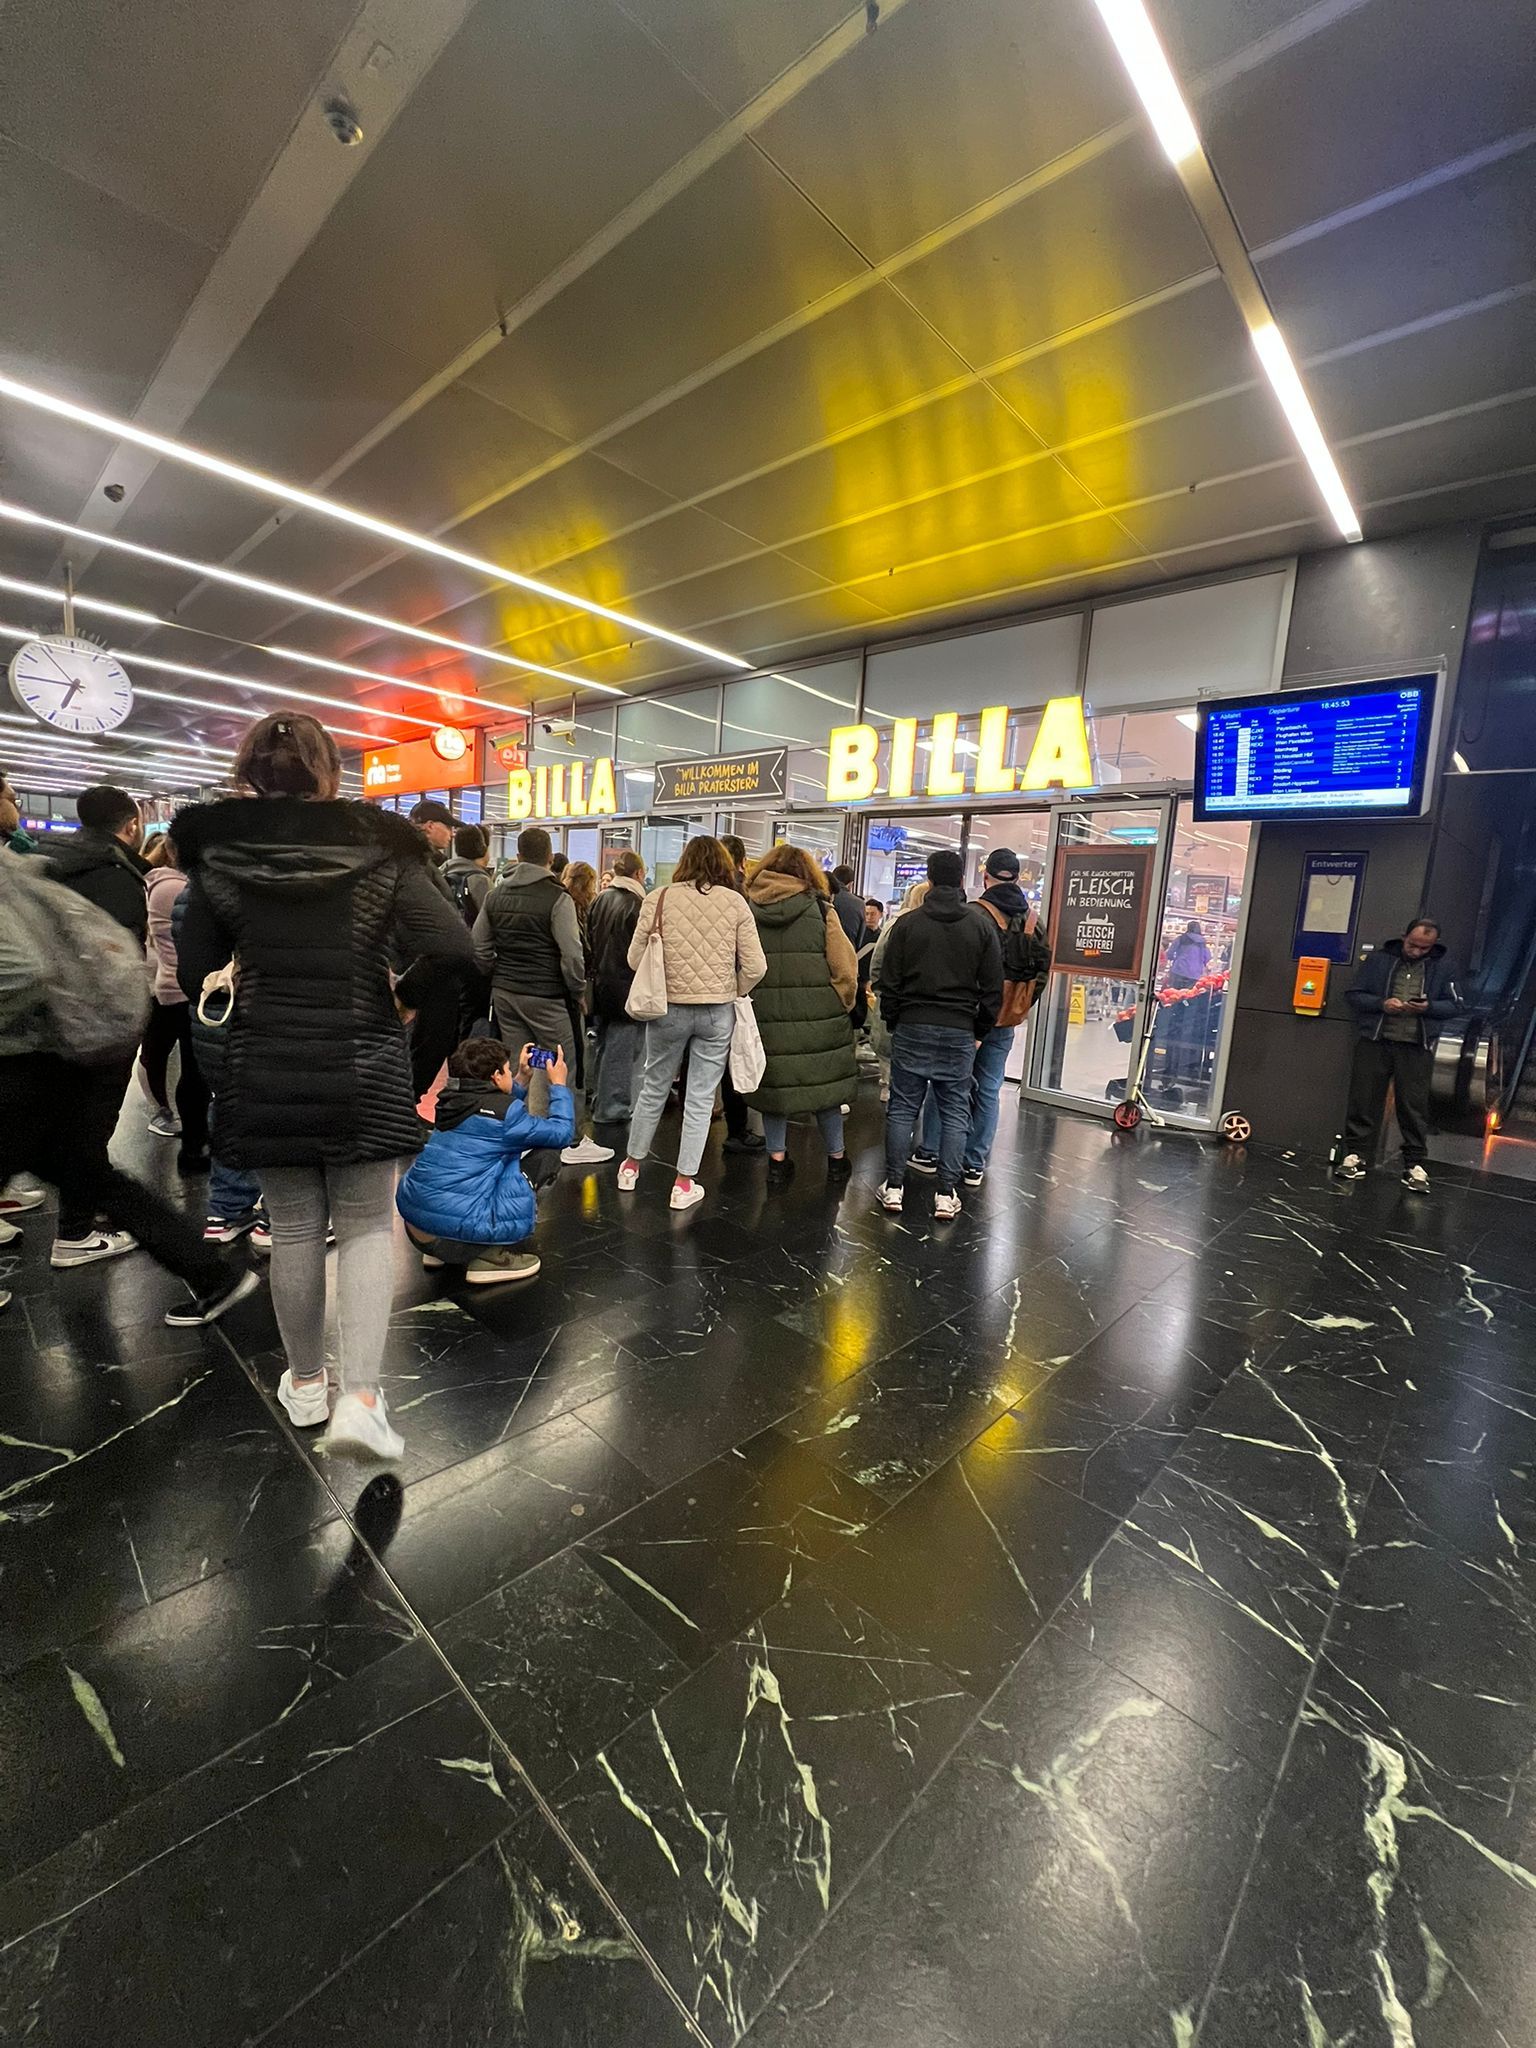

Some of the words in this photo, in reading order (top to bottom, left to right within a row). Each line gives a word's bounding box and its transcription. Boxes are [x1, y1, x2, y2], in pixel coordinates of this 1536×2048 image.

[1268, 706, 1300, 715] Departure
[827, 696, 1093, 801] BILLA
[681, 764, 744, 781] WILLKOMMEN
[747, 761, 759, 775] IM
[508, 757, 617, 819] BILLA
[675, 782, 696, 796] BILLA
[699, 777, 759, 795] PRATERSTERN
[1311, 860, 1358, 869] Entwerter
[1068, 878, 1134, 896] FLEISCH
[1067, 897, 1077, 906] IN
[1077, 925, 1115, 939] FLEISCH
[1075, 938, 1114, 950] MEISTEREI
